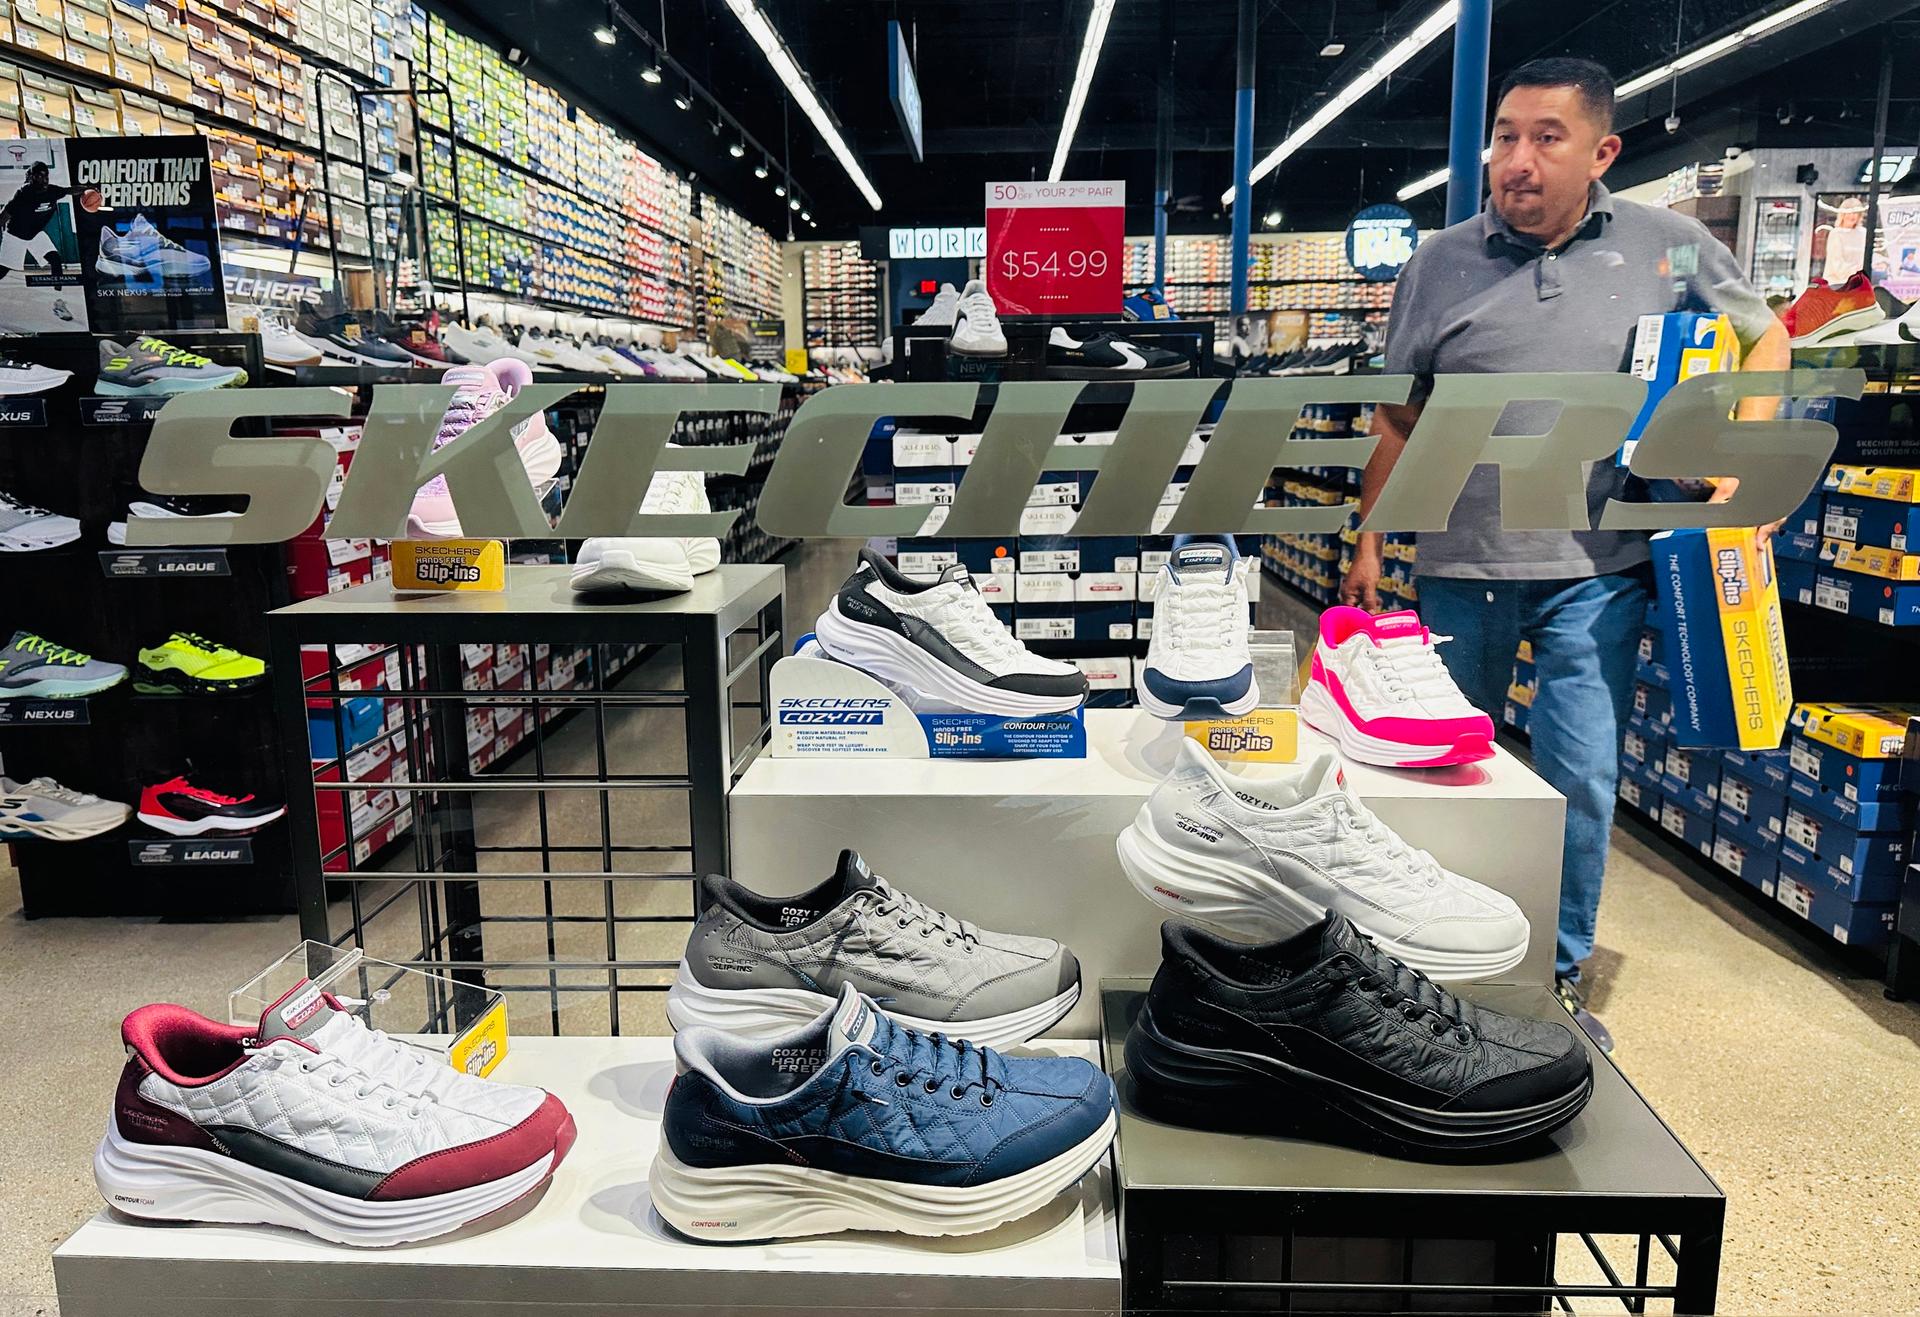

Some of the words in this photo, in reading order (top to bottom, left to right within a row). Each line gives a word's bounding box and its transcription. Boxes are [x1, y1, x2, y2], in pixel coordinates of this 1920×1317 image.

[78, 158, 159, 184] COMFORT
[161, 157, 204, 182] THAT
[101, 182, 191, 207] PERFORMS
[994, 185, 1017, 200] 50
[1035, 188, 1066, 197] YOUR
[1087, 187, 1113, 196] PAIR
[896, 232, 984, 253] WORK
[1002, 249, 1108, 280] $54.99
[97, 289, 115, 297] SKX
[117, 288, 148, 297] NEXUS
[960, 363, 987, 373] NEW
[126, 370, 1867, 547] SKECHERS
[415, 546, 481, 556] SKECHERS
[158, 562, 216, 572] LEAGUE
[1669, 553, 1680, 572] THE
[418, 564, 479, 583] Slip-ins
[1716, 549, 1742, 606] Slip-ins
[1670, 573, 1687, 621] COMFORT
[1678, 621, 1696, 683] TECHNOLOGY
[1733, 620, 1763, 730] SKECHERS
[24, 710, 75, 719] NEXUS
[1686, 683, 1701, 731] COMPANY
[782, 712, 840, 723] COZY
[842, 712, 880, 723] FIT
[932, 718, 986, 726] SKECHERS
[1003, 722, 1046, 730] CONTOUR
[935, 732, 982, 746] Slip-ins
[1209, 733, 1272, 753] Slip-ins
[1235, 790, 1261, 806] COZY
[1175, 812, 1224, 839] SKECHERS
[1177, 821, 1217, 843] SLIP-INS
[183, 850, 240, 860] LEAGUE
[782, 907, 811, 917] COZY
[708, 955, 759, 967] SKECHERS
[712, 963, 753, 973] SLIP-INS
[773, 1048, 807, 1057] COZY
[115, 1194, 140, 1204] CONTOUR
